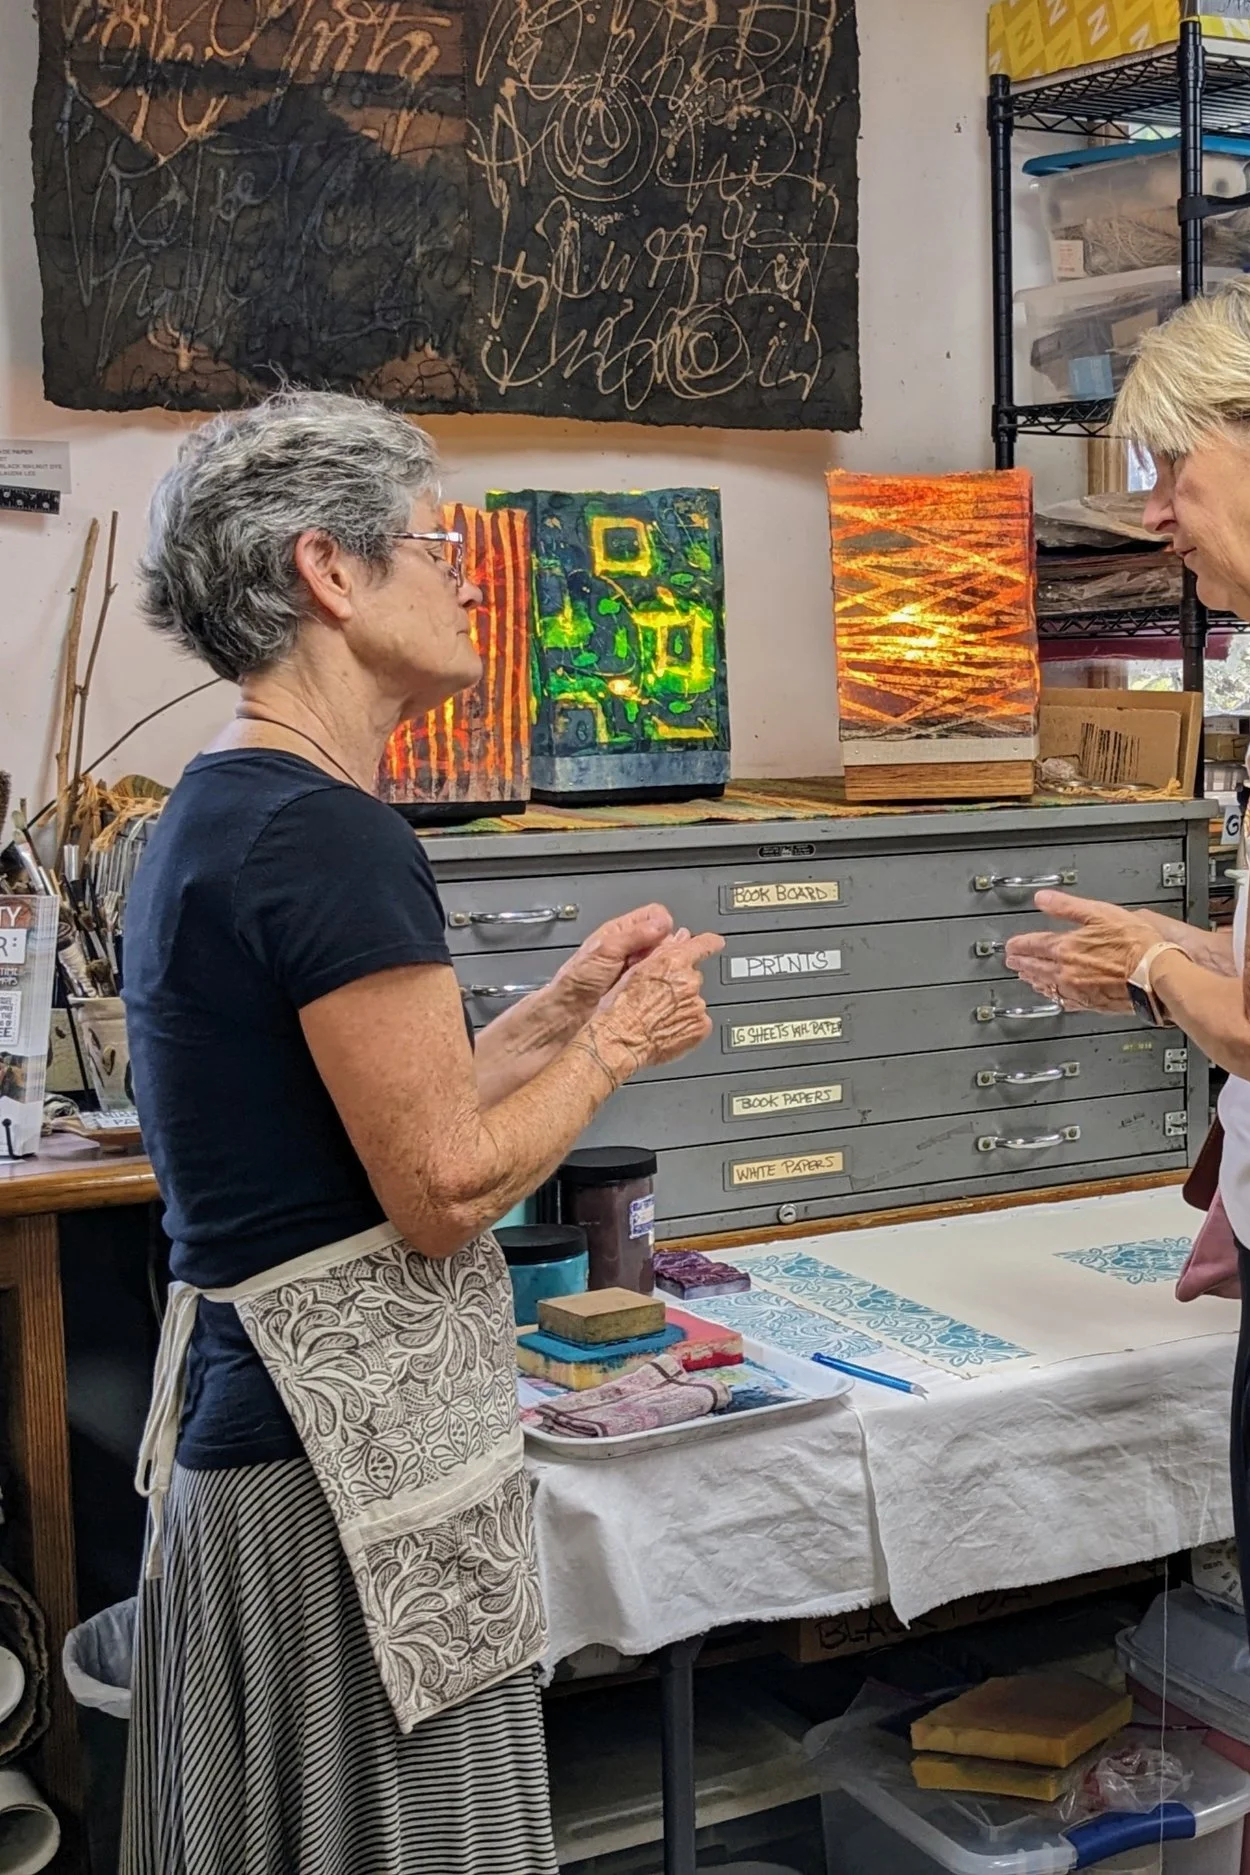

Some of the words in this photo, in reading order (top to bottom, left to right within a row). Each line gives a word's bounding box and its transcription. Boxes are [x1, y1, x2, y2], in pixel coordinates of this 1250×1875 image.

[735, 886, 771, 903] BOOK
[775, 884, 828, 901] BOARD
[745, 950, 829, 977] PRINTS
[747, 1023, 790, 1043] SHEETS
[736, 1094, 779, 1110] BOOK
[781, 1089, 832, 1106] PAPERS
[736, 1163, 777, 1181] WHITE
[780, 1156, 836, 1174] PAPERS
